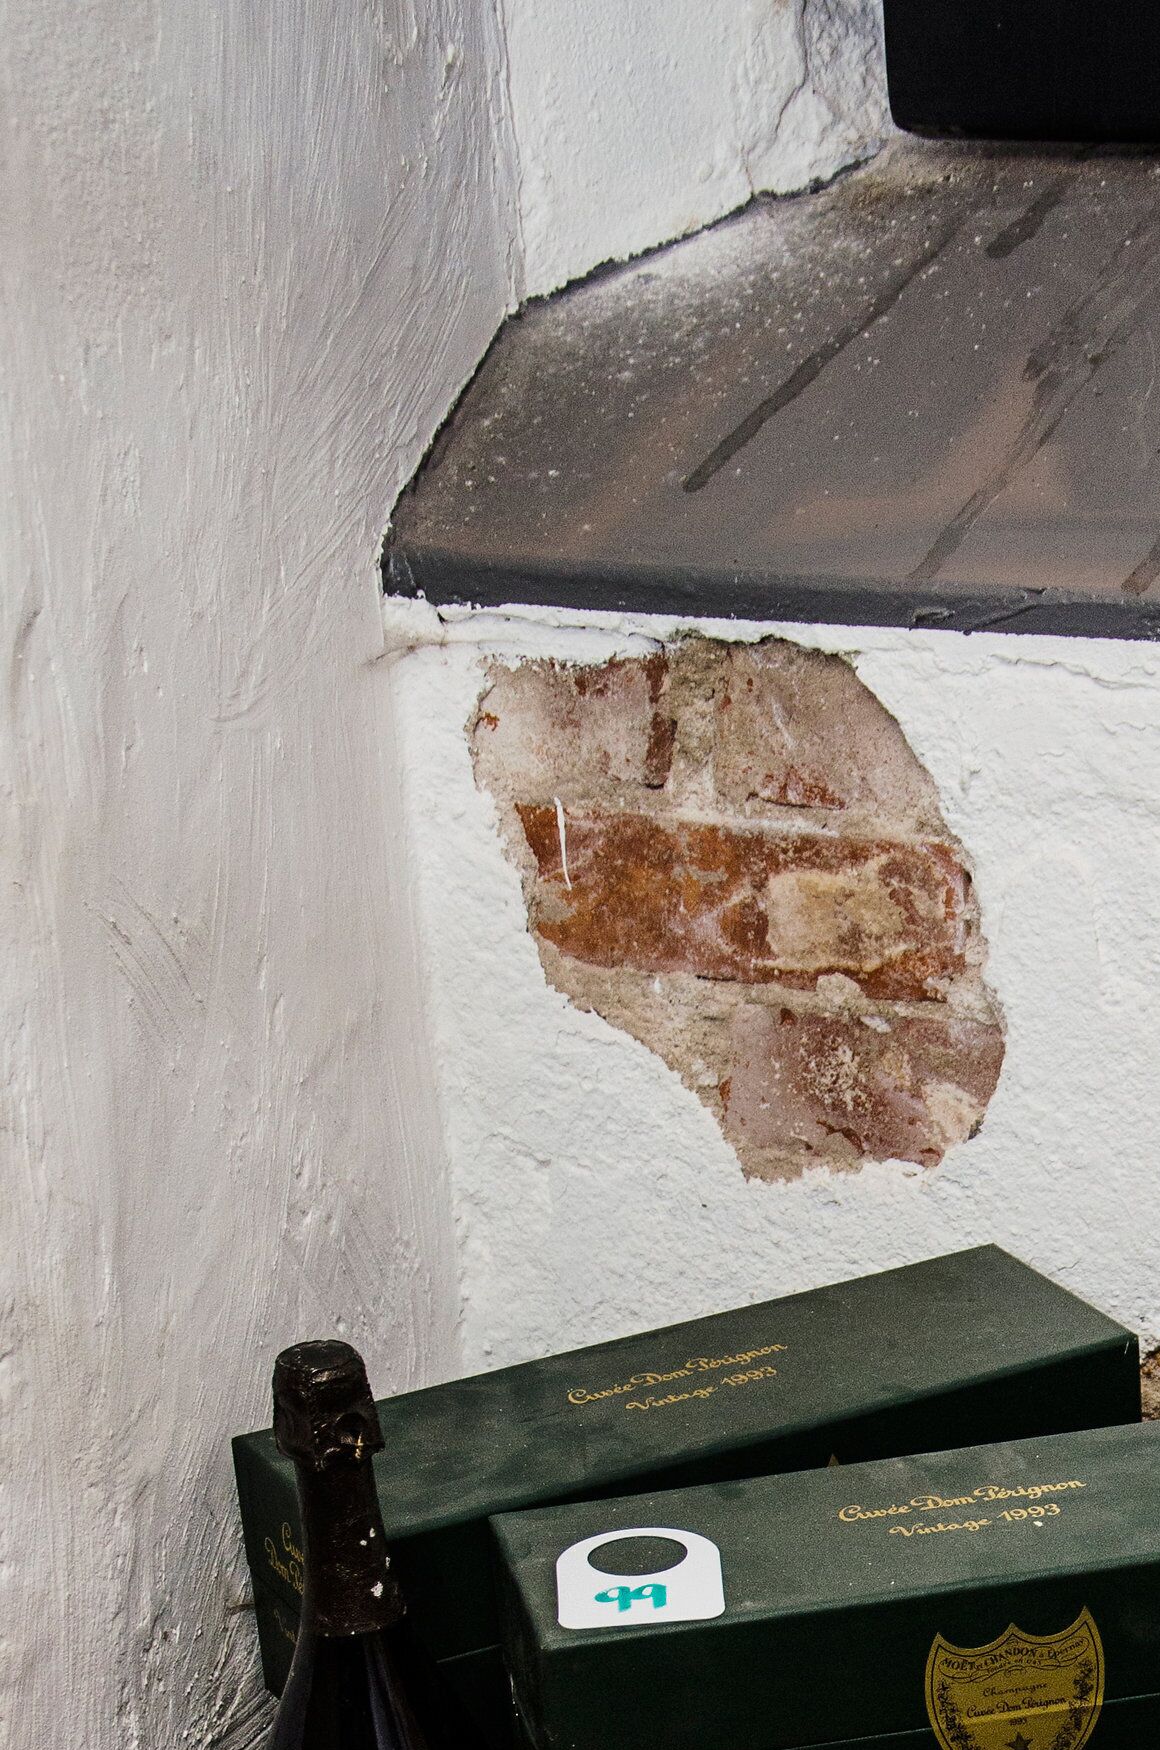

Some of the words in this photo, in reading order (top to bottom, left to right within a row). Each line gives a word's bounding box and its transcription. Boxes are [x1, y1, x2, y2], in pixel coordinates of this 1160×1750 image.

[568, 1383, 637, 1404] Cuvée
[630, 1371, 693, 1386] Dom
[625, 1386, 718, 1410] Vintage
[721, 1366, 777, 1386] 1993
[838, 1504, 912, 1522] Cuvée
[910, 1495, 977, 1511] Dom
[973, 1480, 1087, 1500] Pérignon
[889, 1518, 991, 1537] Vintage
[997, 1503, 1061, 1522] 1993
[594, 1583, 667, 1613] 99
[982, 1682, 1047, 1698] Champagne
[966, 1705, 996, 1719] Cuvée
[997, 1702, 1022, 1714] Dom
[1023, 1695, 1068, 1709] Pérignon
